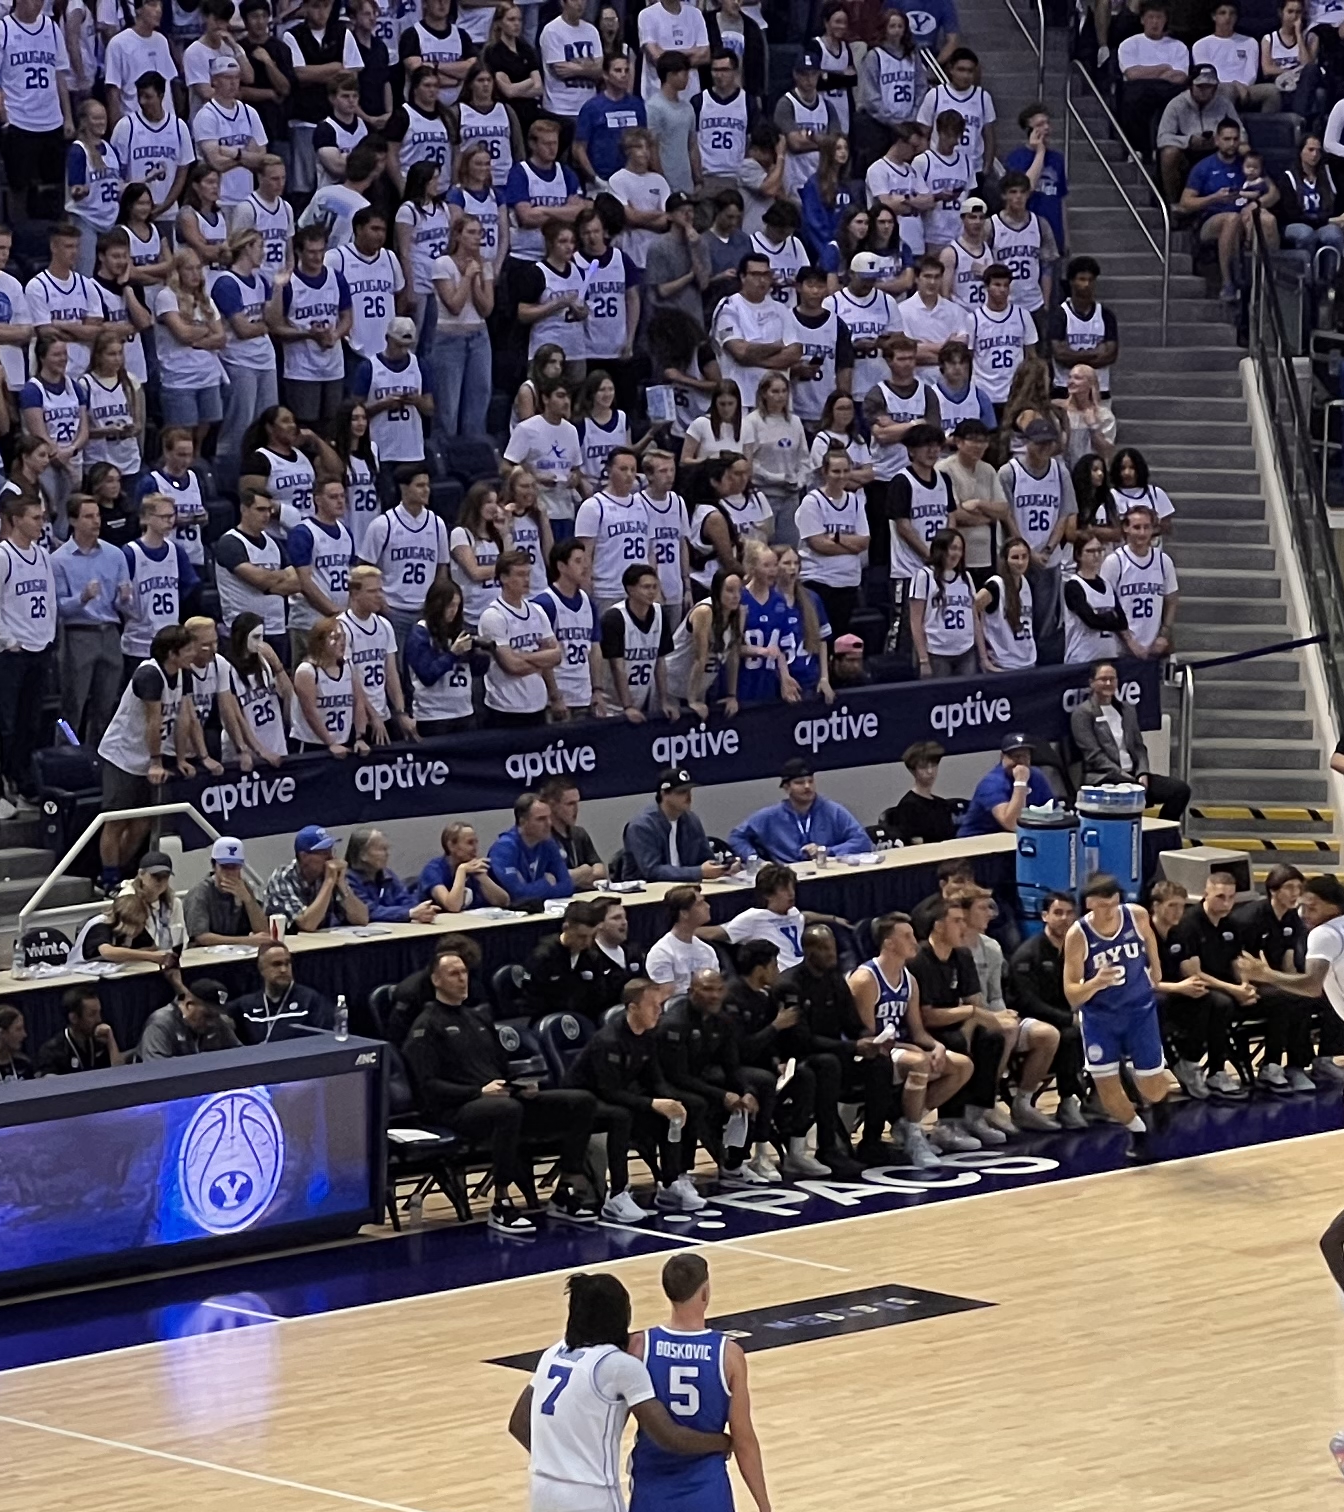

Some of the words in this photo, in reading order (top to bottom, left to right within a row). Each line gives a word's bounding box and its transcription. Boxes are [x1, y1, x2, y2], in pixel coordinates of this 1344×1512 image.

[25, 68, 48, 88] 26
[894, 84, 912, 101] 26
[712, 131, 732, 149] 26
[1009, 261, 1030, 279] 26
[363, 297, 385, 317] 26
[594, 300, 617, 317] 26
[991, 350, 1013, 368] 26
[356, 490, 376, 511] 26
[1028, 510, 1049, 531] 26
[623, 538, 646, 559] 26
[403, 563, 425, 584] 26
[153, 595, 173, 614] 26
[1132, 598, 1154, 618] 26
[945, 609, 965, 629] 26
[363, 665, 384, 686] 26
[628, 665, 651, 685] 26
[930, 691, 1011, 736] aptive
[794, 706, 878, 752] aptive
[652, 722, 739, 768] aptive
[506, 741, 596, 783] aptive
[356, 754, 449, 798] aptive
[201, 770, 296, 819] aptive
[354, 1053, 377, 1066] ANC
[655, 1339, 713, 1362] BOSKOVIC
[540, 1366, 574, 1416] 7
[669, 1366, 701, 1417] 5
